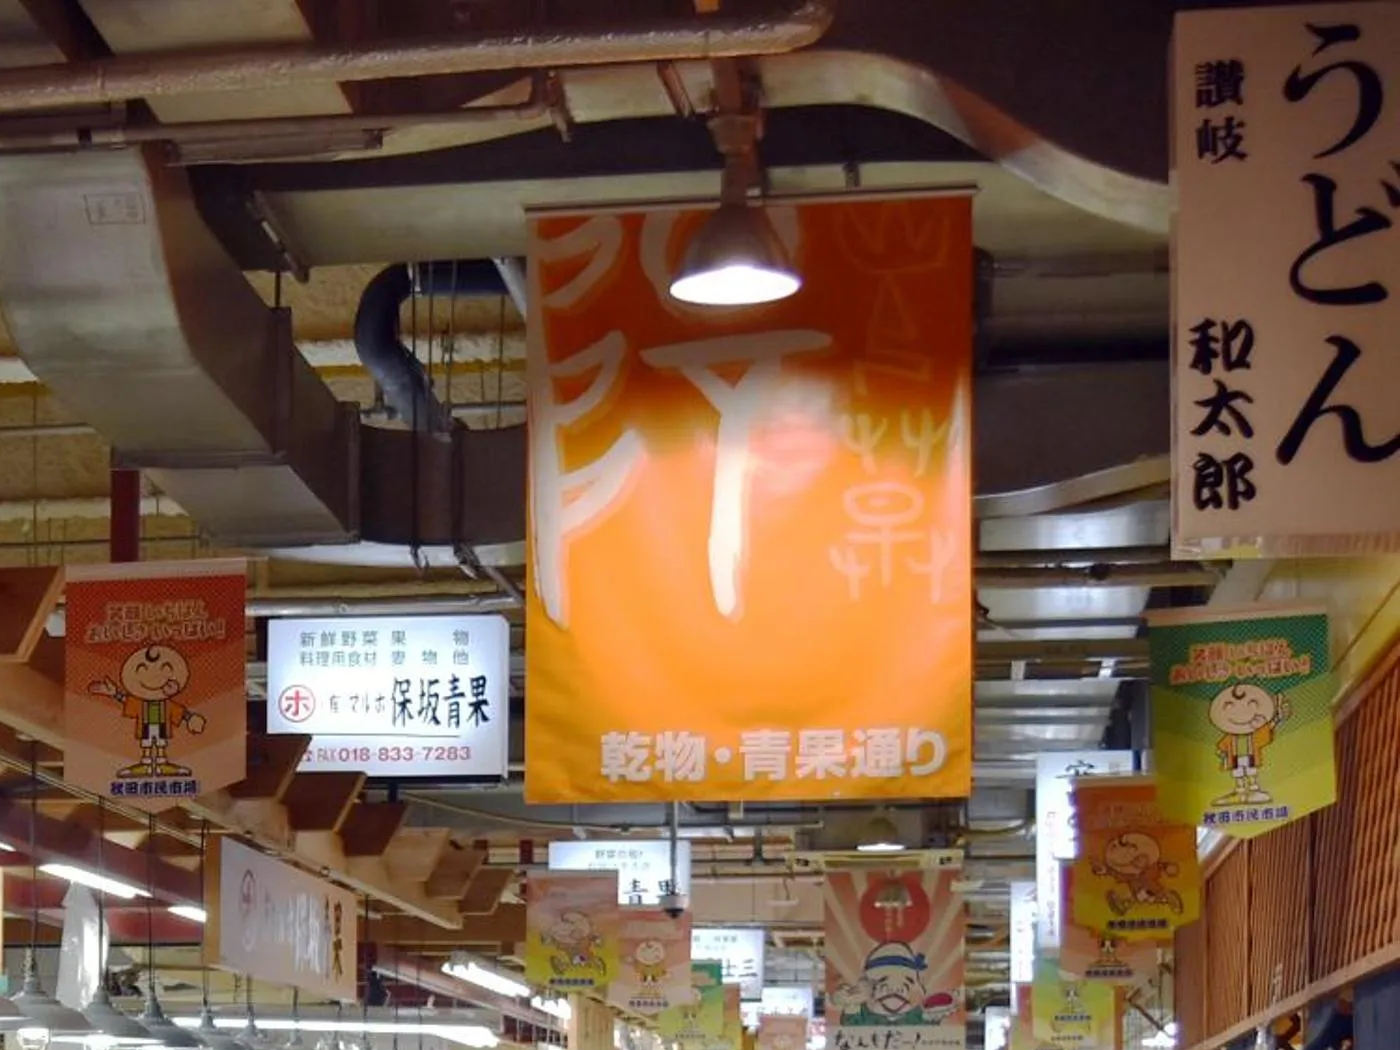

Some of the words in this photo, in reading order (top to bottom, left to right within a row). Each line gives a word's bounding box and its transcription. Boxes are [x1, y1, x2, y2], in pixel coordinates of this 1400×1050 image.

[1276, 22, 1400, 466] うどん
[1187, 317, 1256, 511] 和太郎
[300, 630, 378, 648] 新鮮野菜
[391, 673, 490, 728] 保坂青果
[600, 726, 948, 784] 乾物・青果通り
